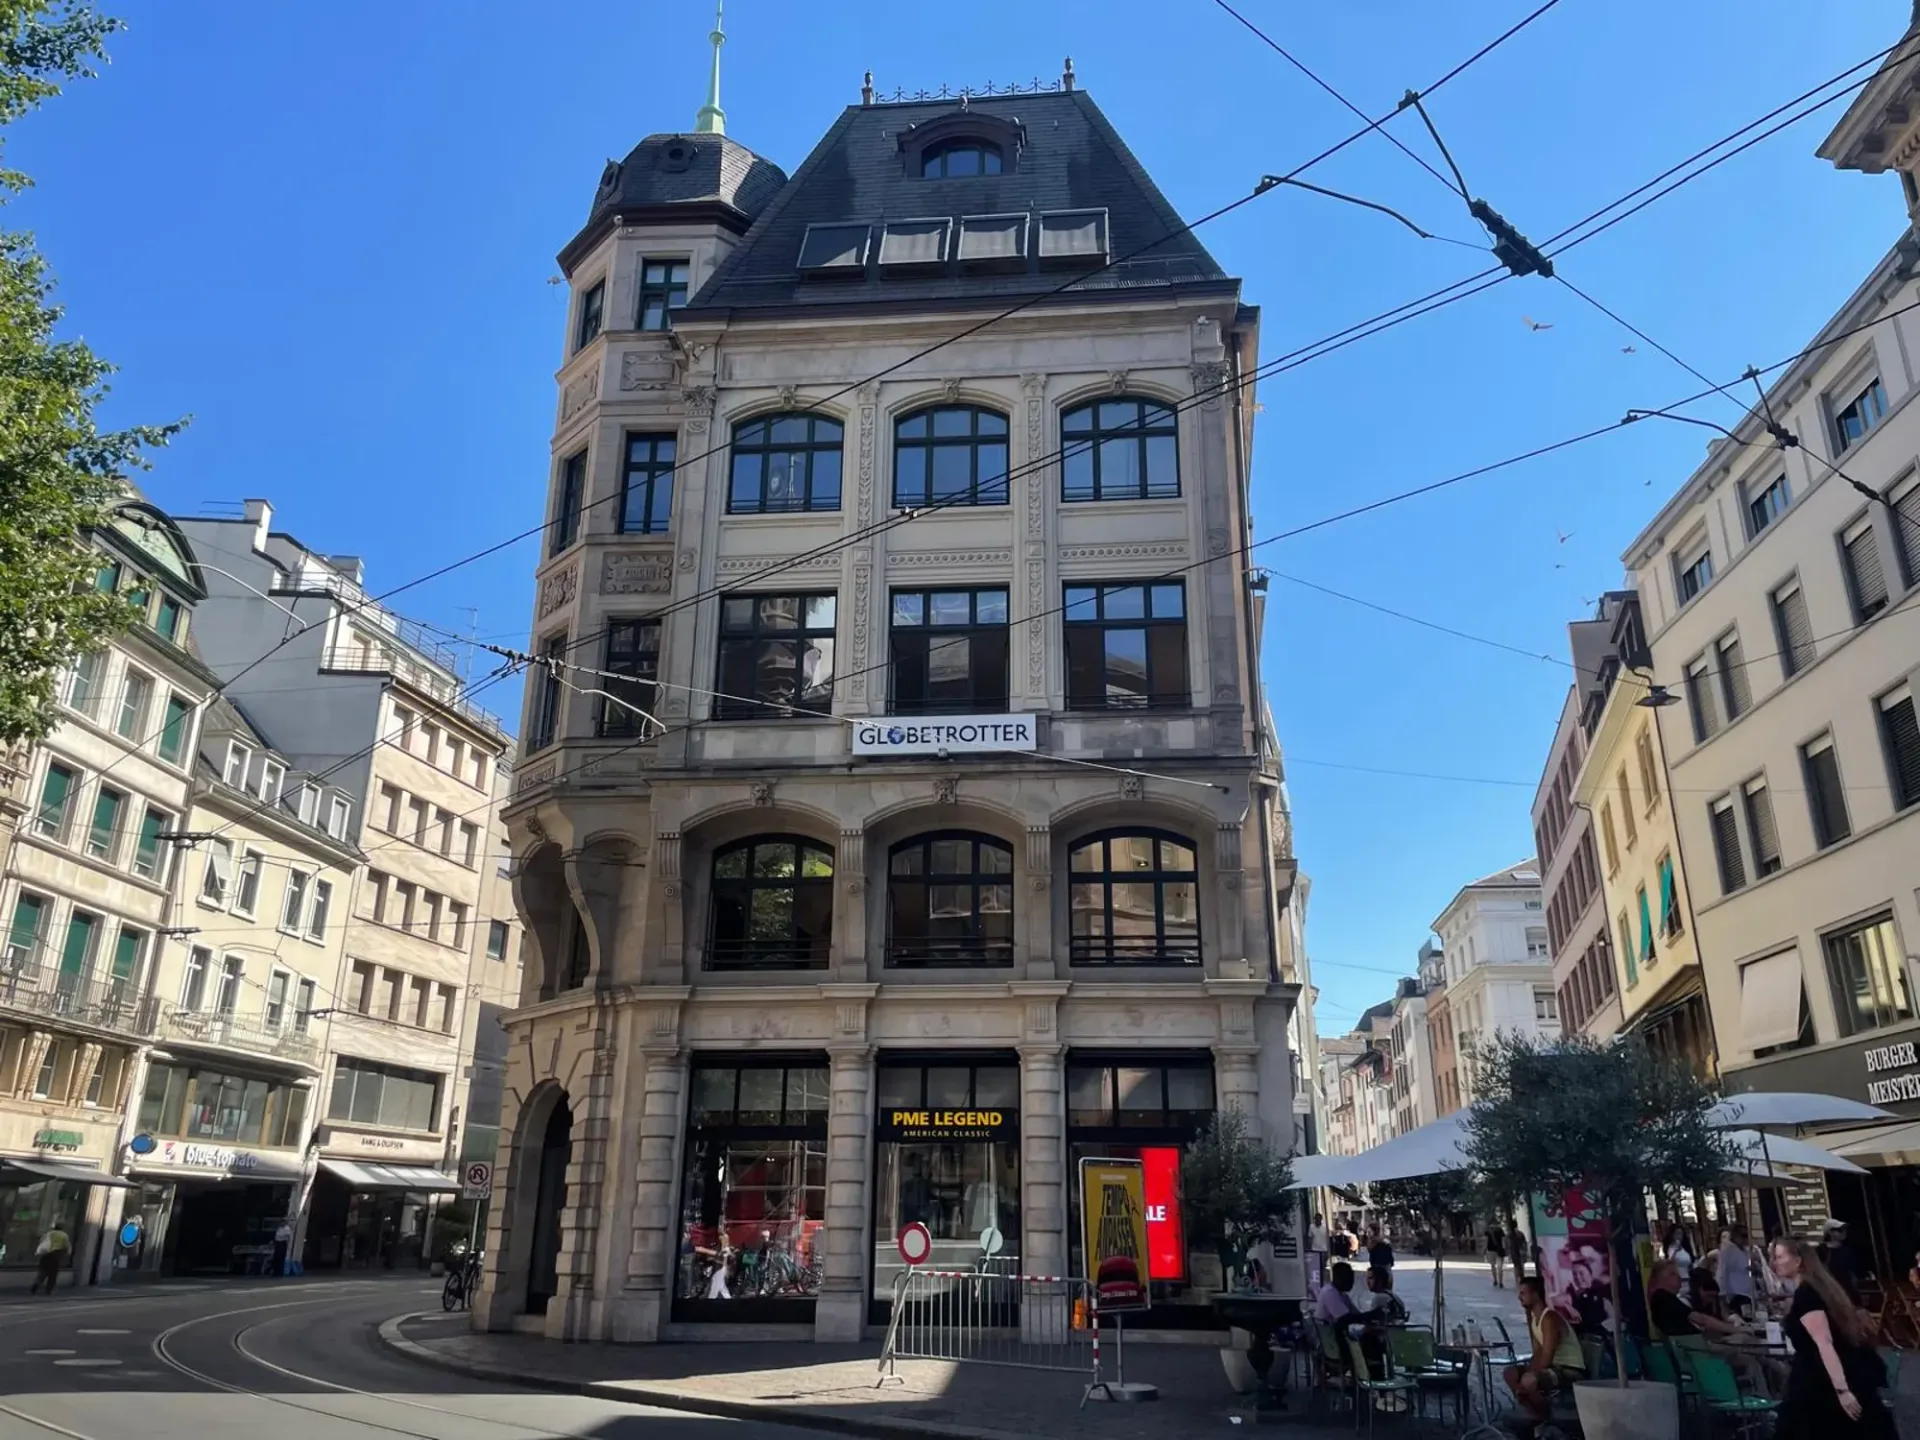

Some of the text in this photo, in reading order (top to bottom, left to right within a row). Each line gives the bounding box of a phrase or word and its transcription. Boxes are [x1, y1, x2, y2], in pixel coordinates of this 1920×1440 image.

[859, 724, 1029, 745] GLOBETROTTER
[1864, 1041, 1918, 1072] BURGER
[892, 1111, 1003, 1126] PME LEGEND
